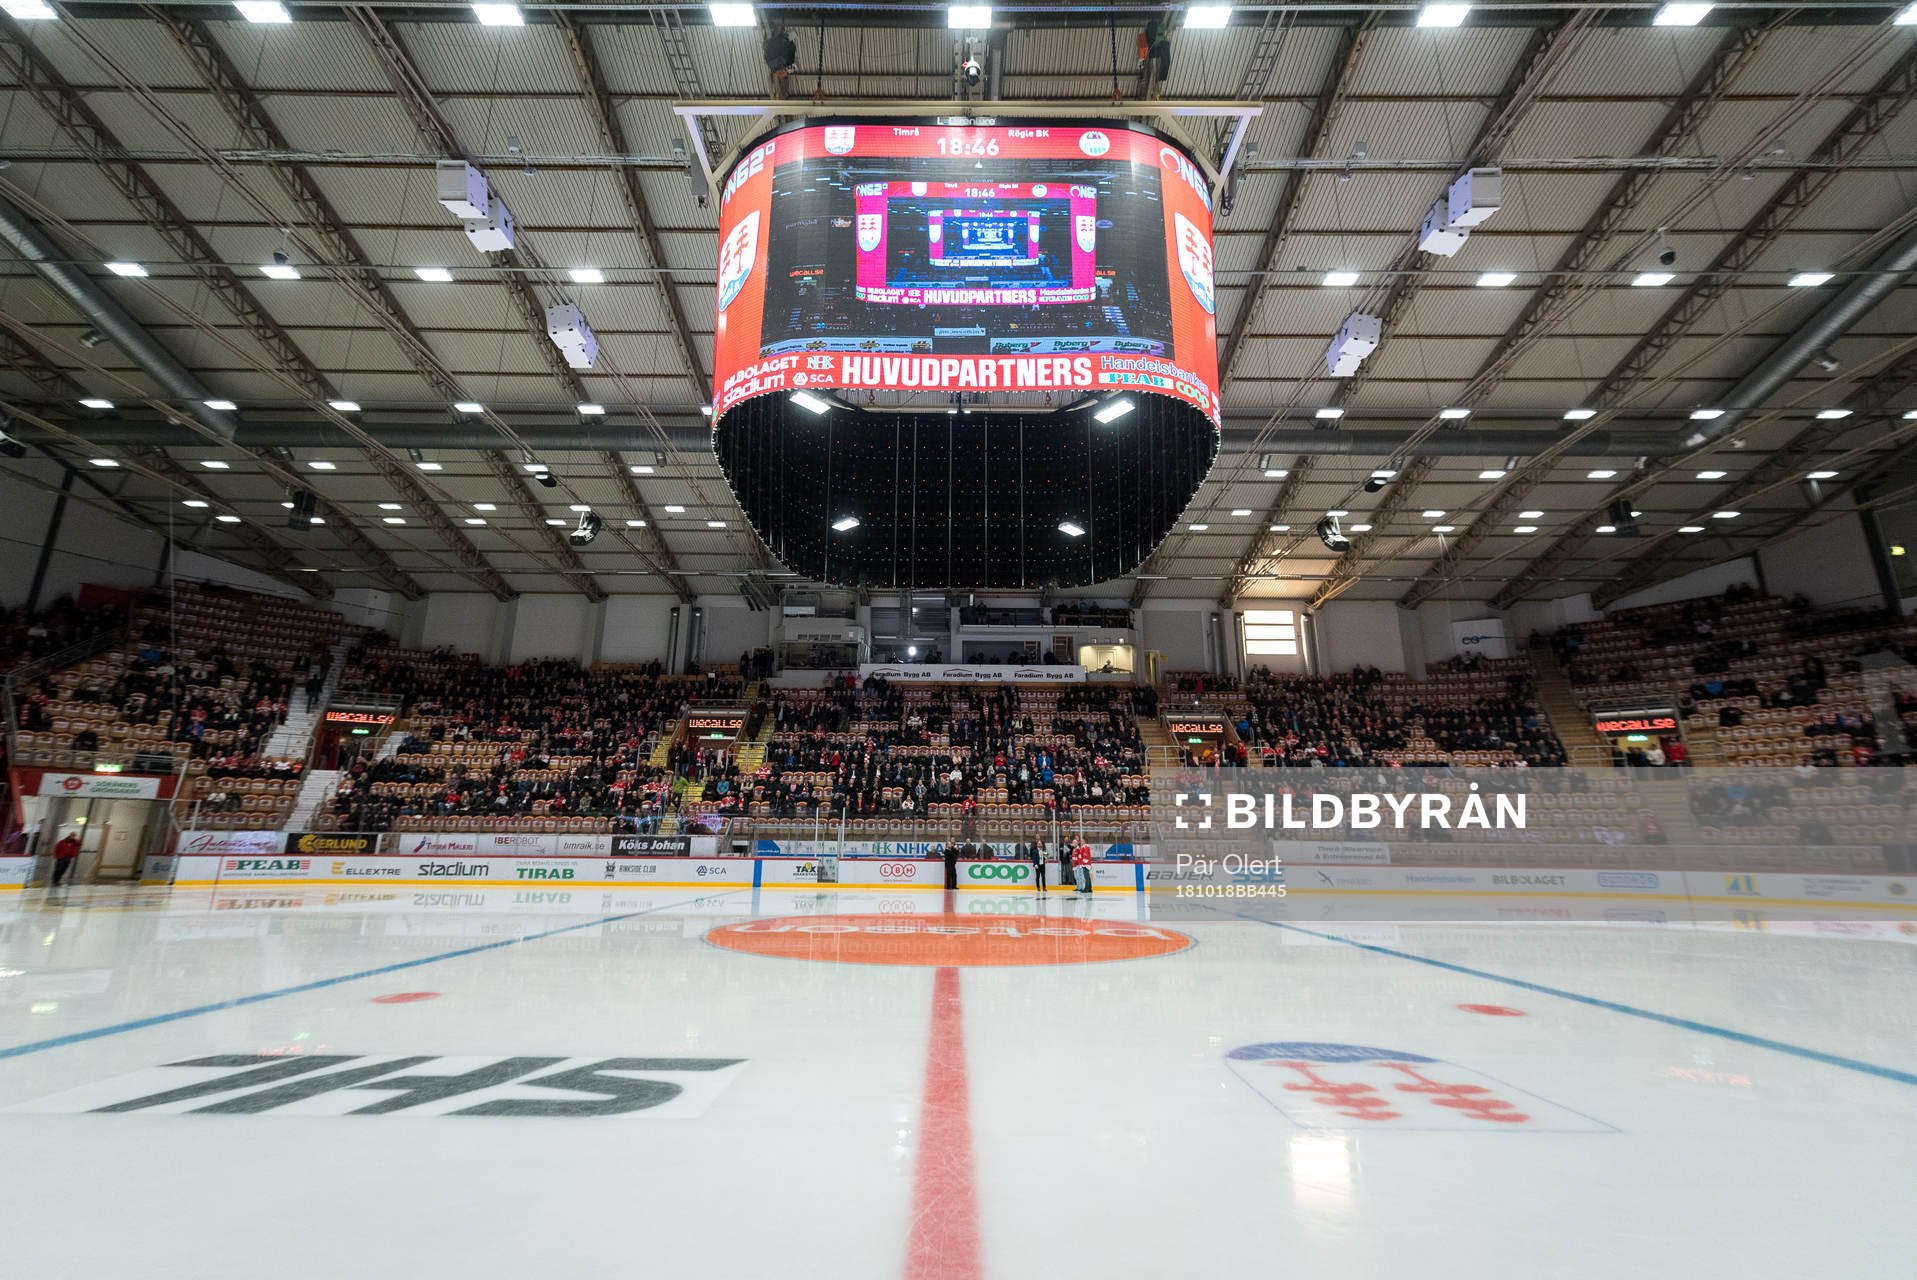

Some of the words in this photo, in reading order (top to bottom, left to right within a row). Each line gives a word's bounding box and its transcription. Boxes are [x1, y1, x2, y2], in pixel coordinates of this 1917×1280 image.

[892, 127, 920, 136] Timrå
[1035, 130, 1049, 138] BK
[936, 137, 1000, 156] 18:46
[964, 188, 995, 198] 18:46
[923, 289, 1037, 304] HUVUDPARTNERS
[724, 356, 800, 391] BILBOLAGET
[841, 356, 1093, 388] HUVUDPARTNERS
[810, 373, 834, 384] SCA
[1108, 373, 1165, 388] PEAB
[618, 839, 648, 850] Köks
[650, 839, 685, 850] Johan
[896, 842, 930, 855] NHK
[237, 860, 300, 871] PEAB
[418, 861, 489, 877] stadium
[709, 866, 727, 875] SCA
[516, 868, 575, 879] TIRAB
[968, 864, 1030, 883] coop
[1406, 874, 1476, 884] Handelsbanken
[1492, 875, 1566, 886] BILBOLAGET
